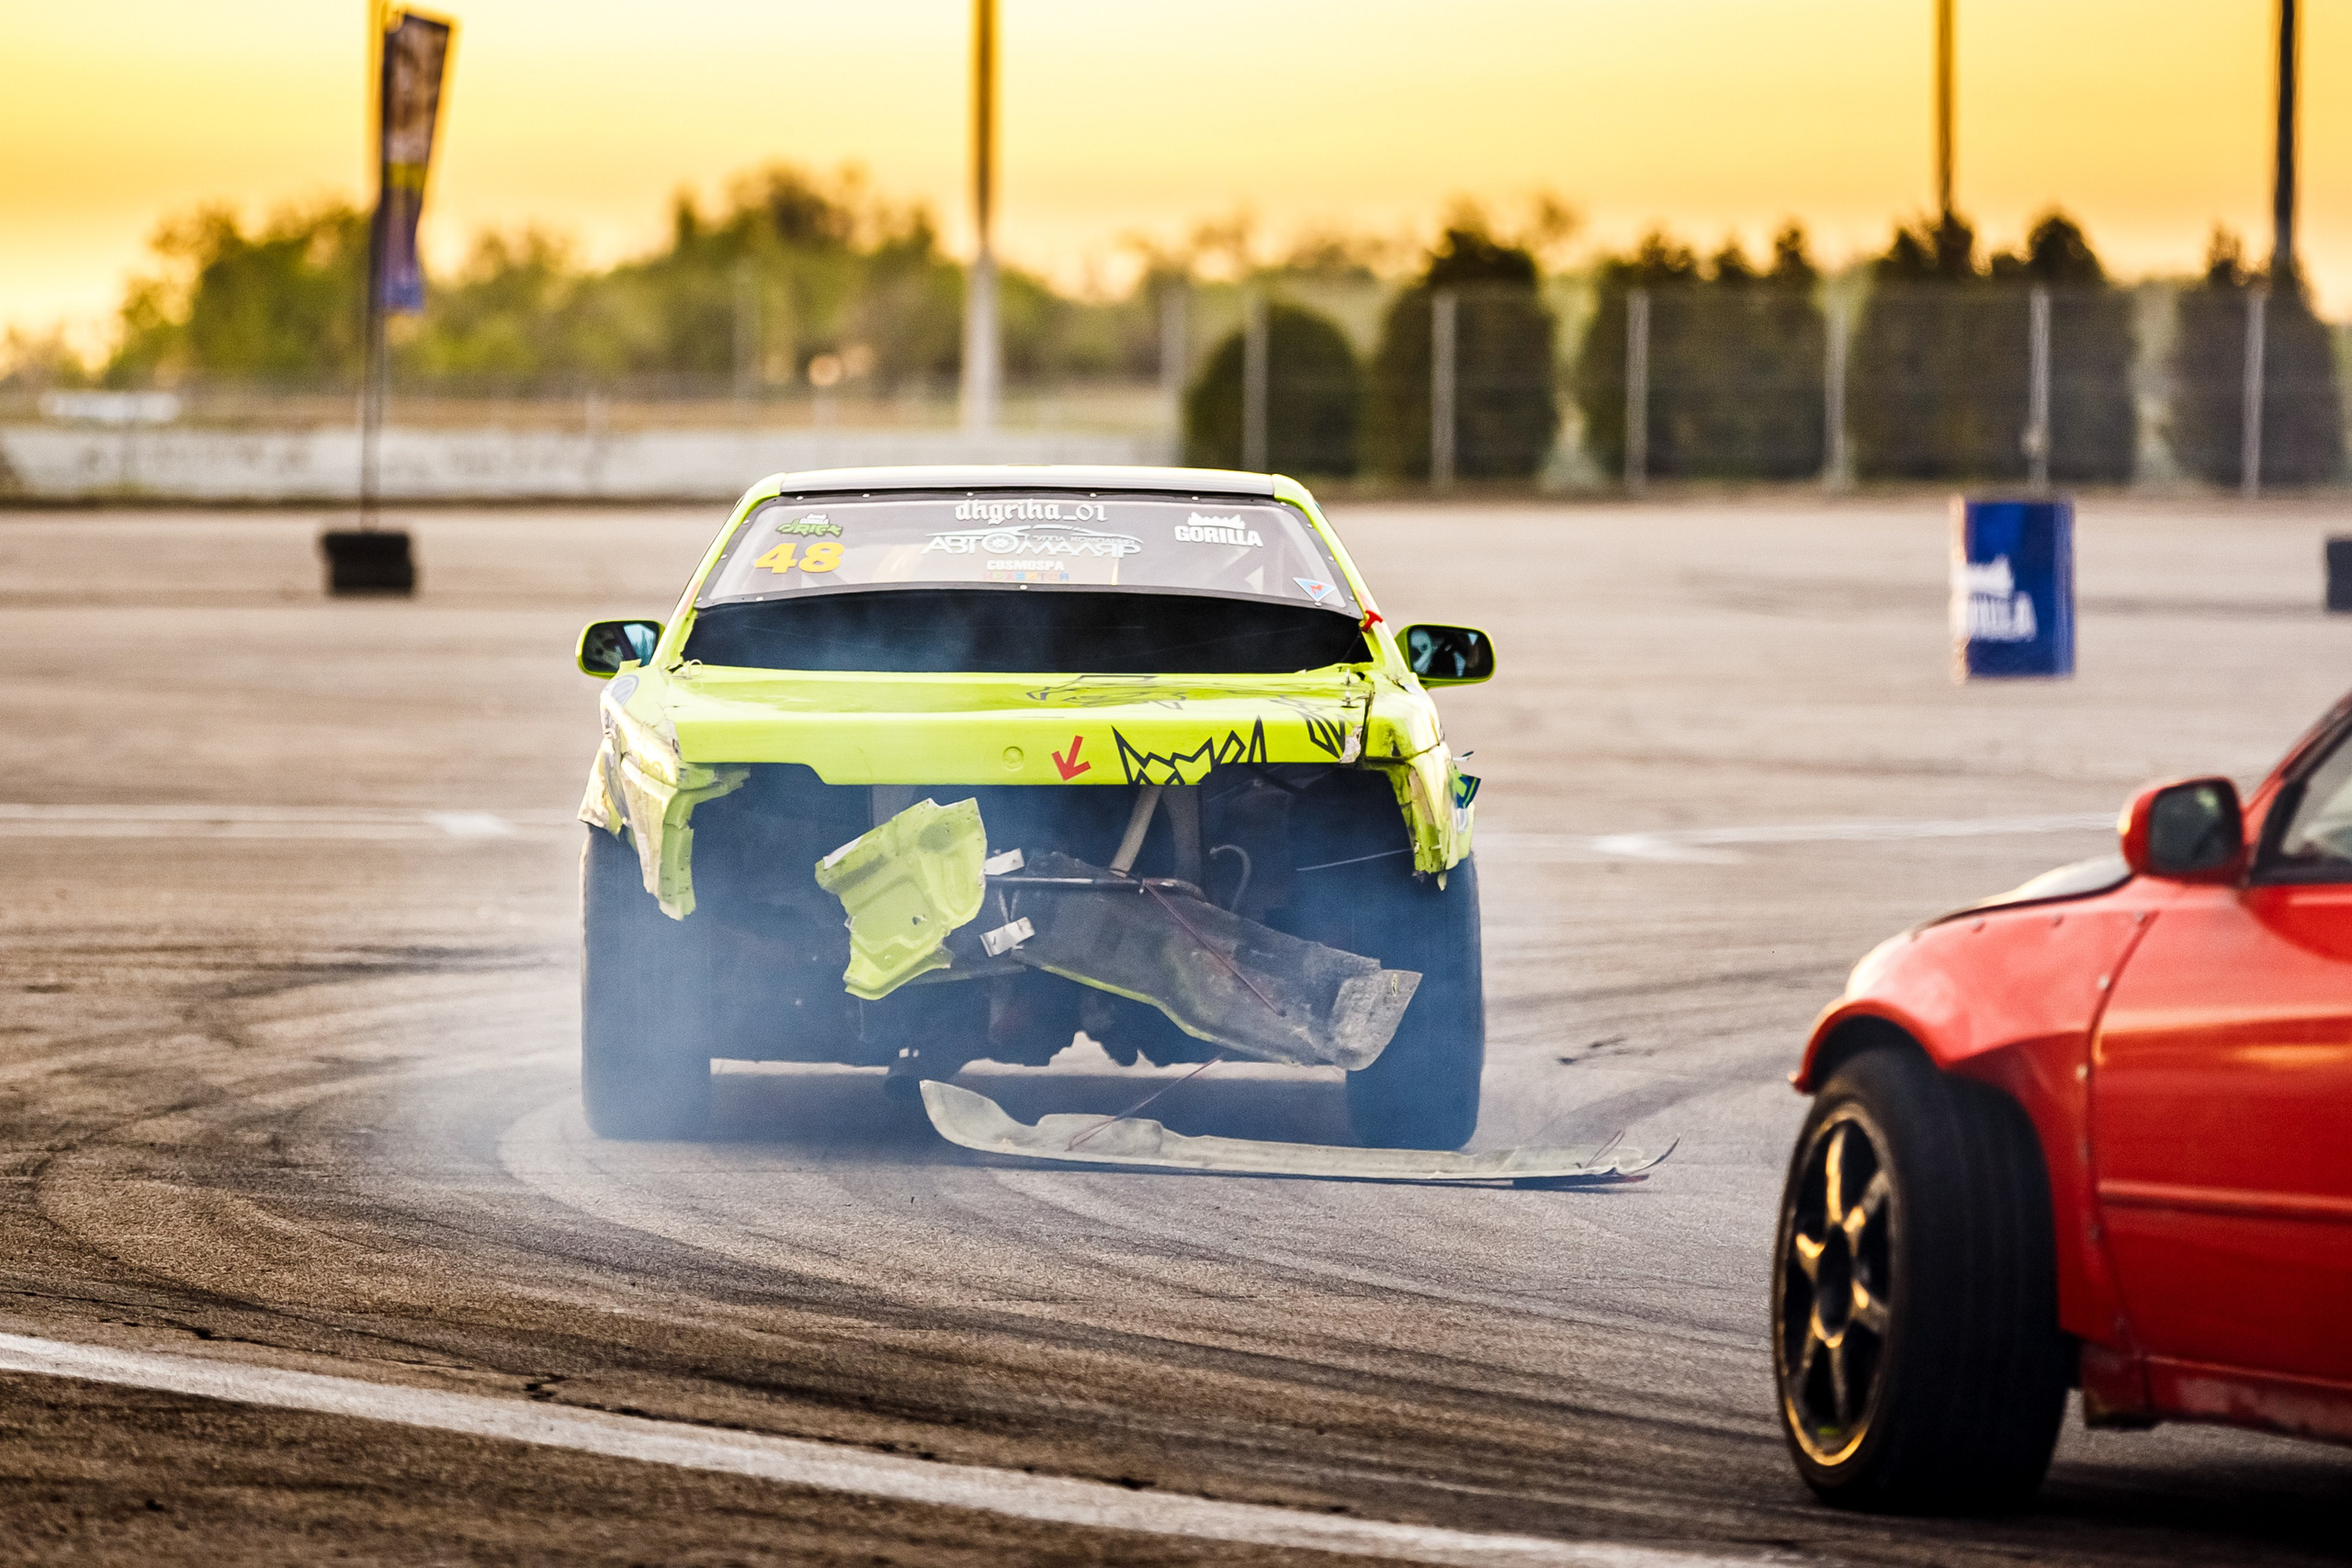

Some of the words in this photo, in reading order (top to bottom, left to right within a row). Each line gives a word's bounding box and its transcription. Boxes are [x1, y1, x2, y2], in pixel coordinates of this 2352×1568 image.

[1174, 525, 1263, 547] GORILLA
[754, 542, 844, 574] 48
[987, 559, 1065, 570] COSMOSPA
